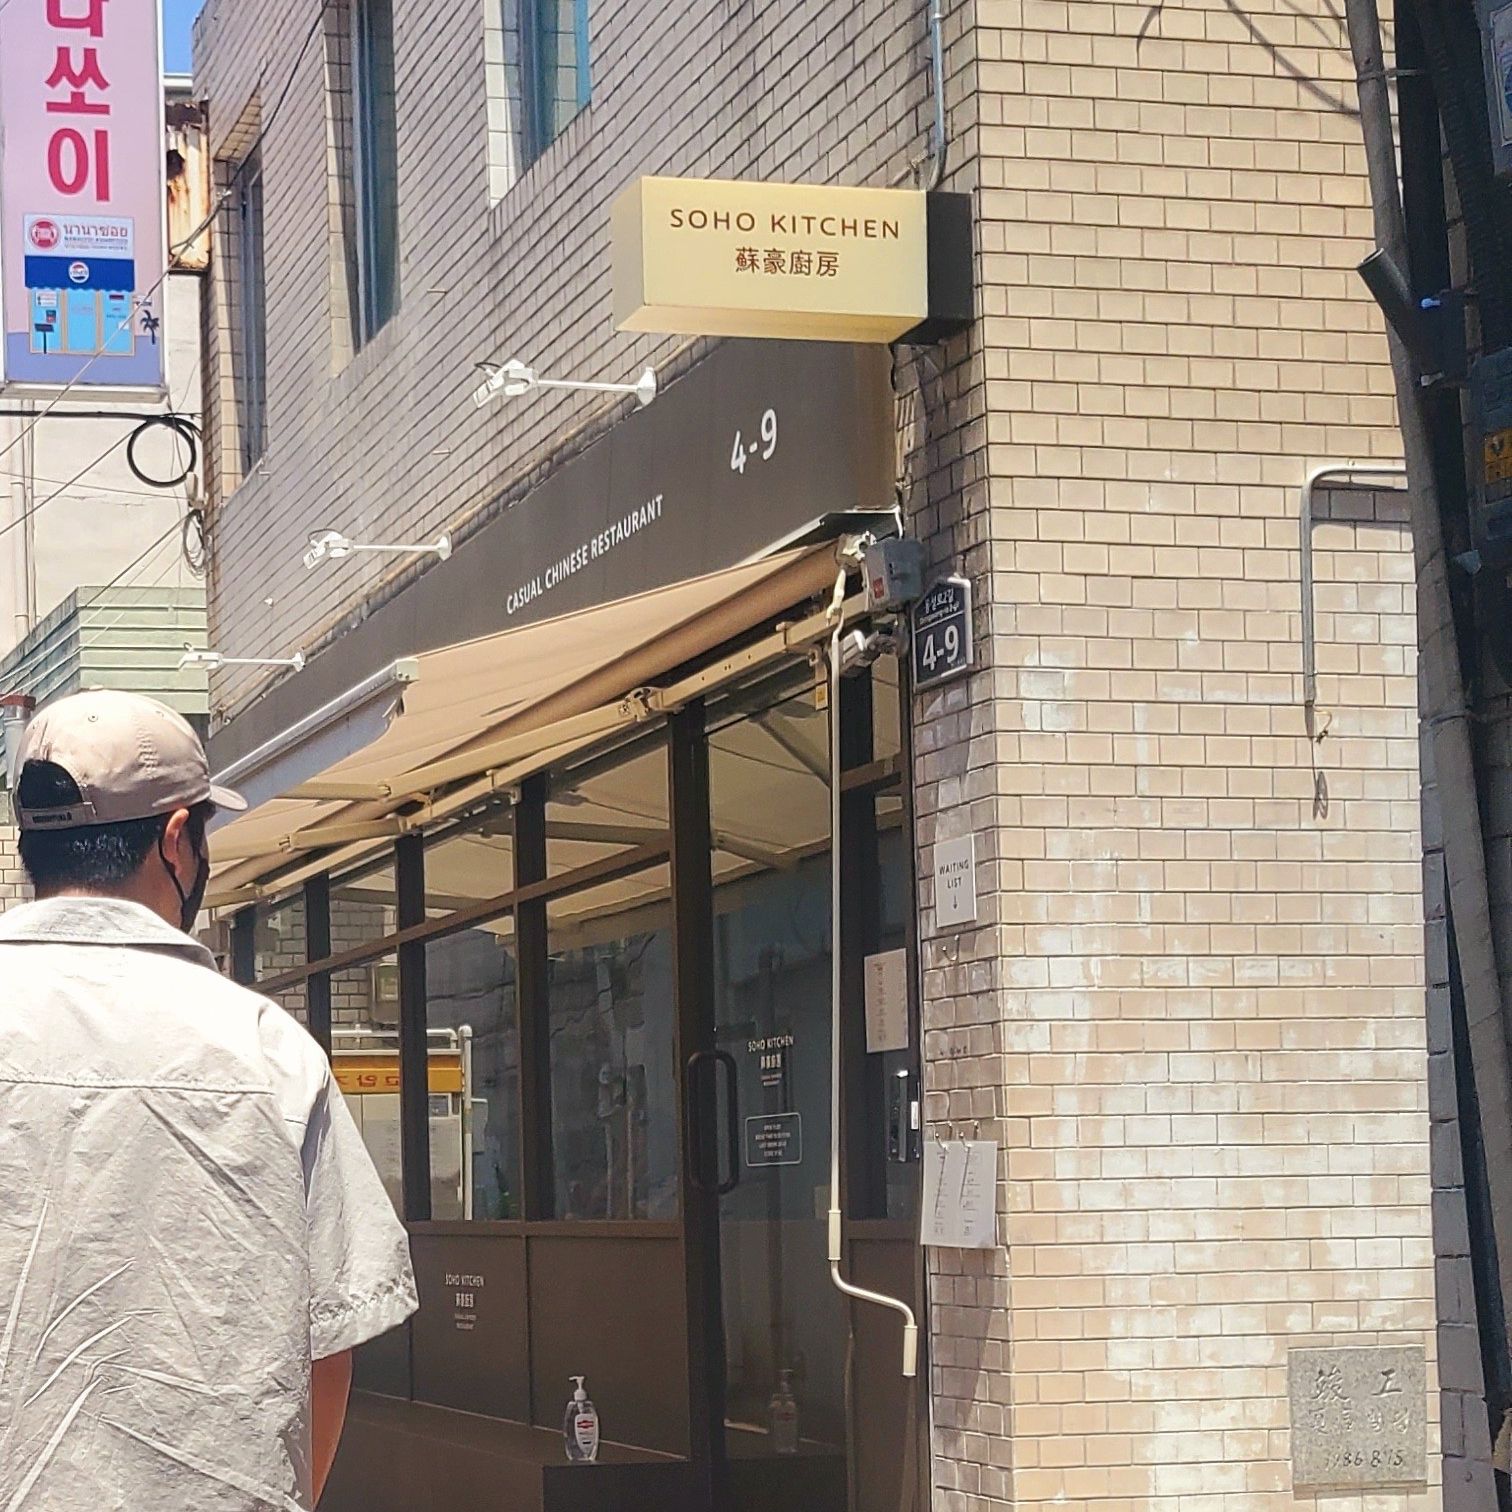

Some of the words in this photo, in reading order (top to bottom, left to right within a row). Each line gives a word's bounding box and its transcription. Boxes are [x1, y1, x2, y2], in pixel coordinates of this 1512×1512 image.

[670, 208, 757, 232] SOHO
[771, 214, 900, 240] KITCHEN
[735, 246, 840, 278] 蘇豪廚房
[730, 408, 778, 475] 4-9
[506, 576, 543, 615] CASUAL
[545, 544, 589, 590] CHINESE
[591, 494, 663, 560] RESTAURANT
[922, 624, 959, 671] 4-9
[939, 859, 969, 875] WAITING
[947, 877, 962, 889] LIST
[748, 1039, 765, 1052] SOHO
[767, 1035, 794, 1048] KITCHEN
[445, 1273, 460, 1286] SOHO
[461, 1274, 484, 1287] KITCHEN
